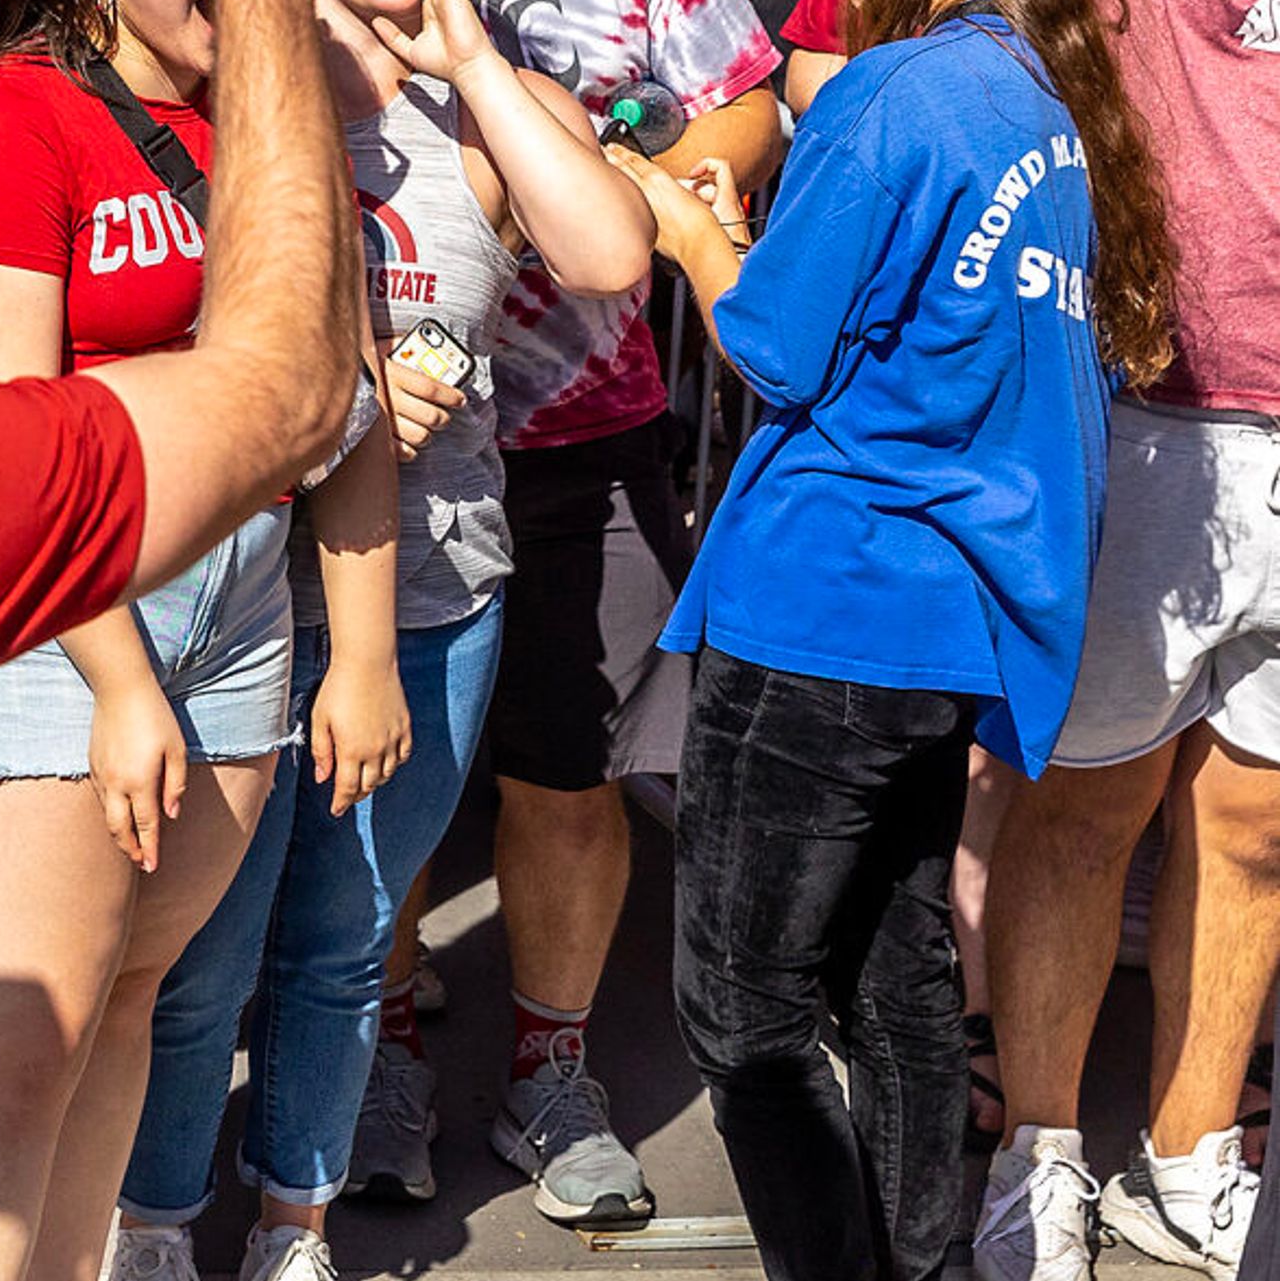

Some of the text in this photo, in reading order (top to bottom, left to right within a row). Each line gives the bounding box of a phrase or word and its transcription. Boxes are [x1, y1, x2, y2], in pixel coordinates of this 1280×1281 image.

[952, 132, 1089, 290] CROWD MA
[375, 267, 438, 305] STATE
